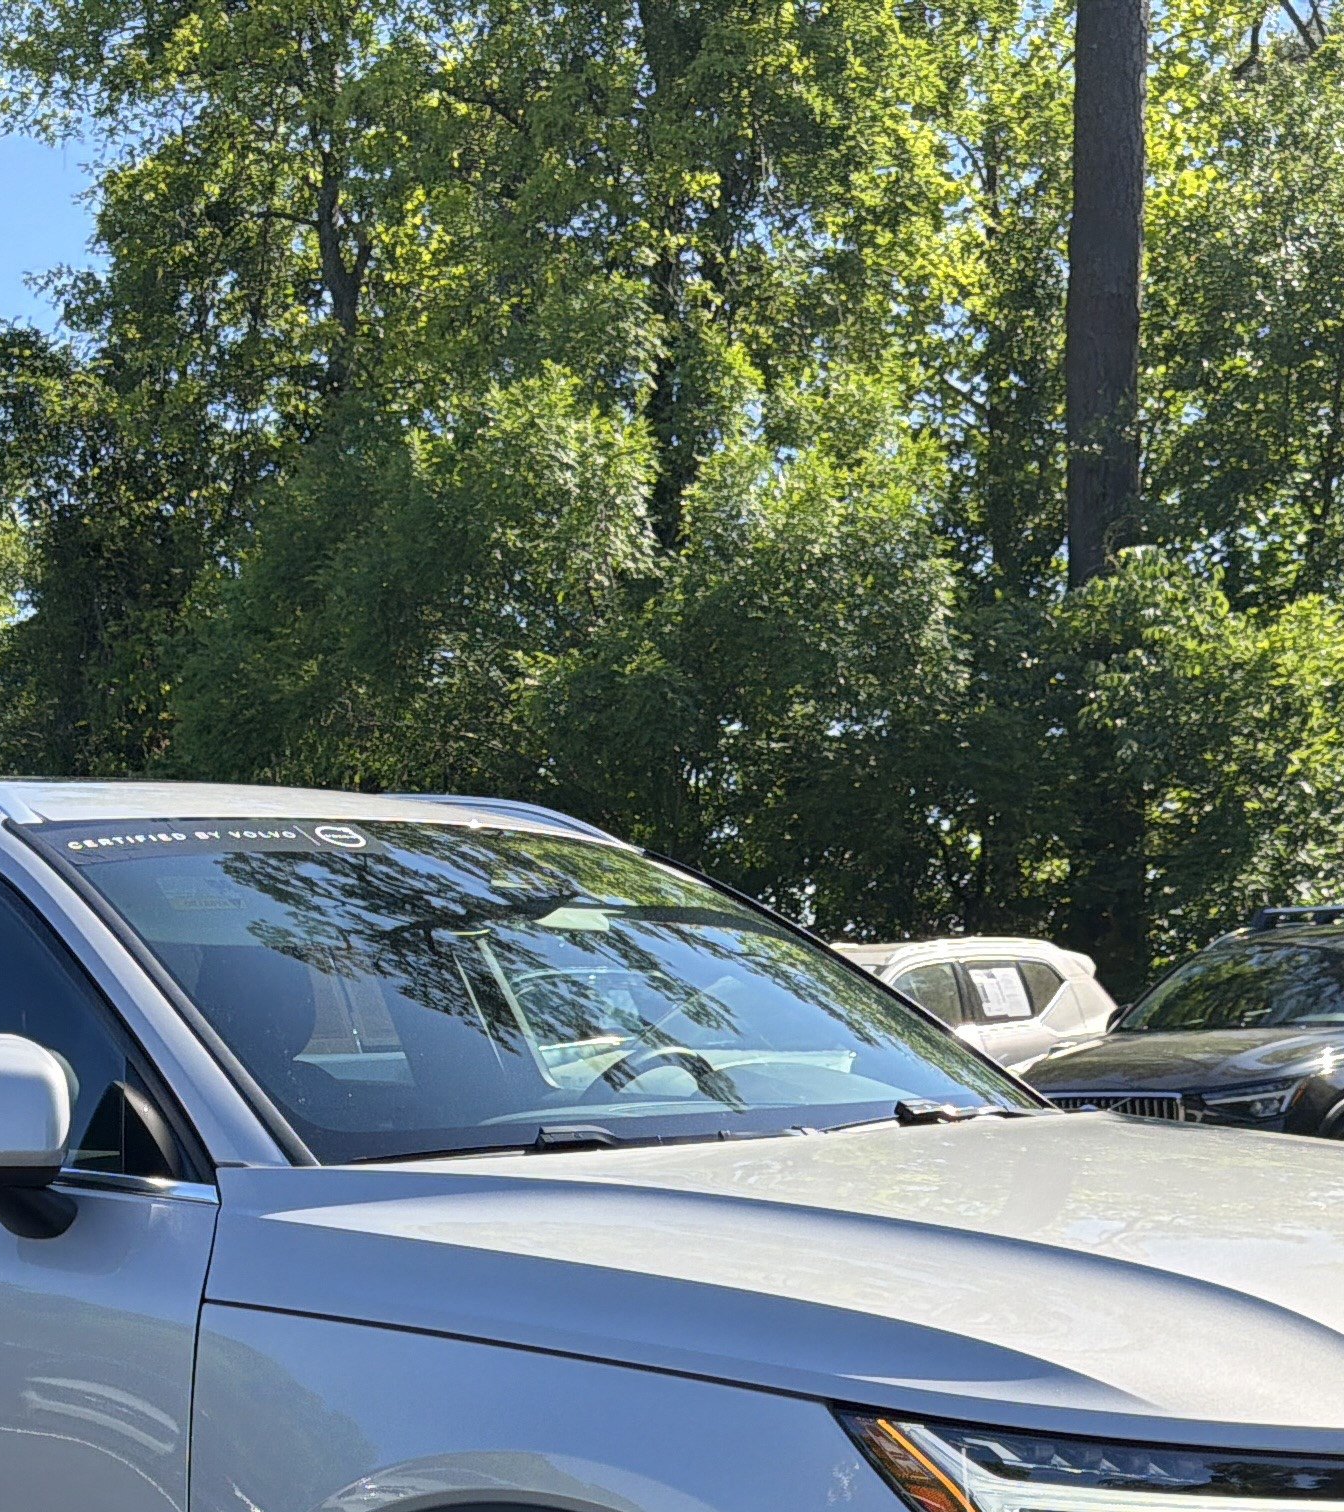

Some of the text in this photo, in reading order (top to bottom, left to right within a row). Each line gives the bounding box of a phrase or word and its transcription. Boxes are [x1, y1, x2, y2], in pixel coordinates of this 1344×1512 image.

[67, 830, 297, 850] CERTIFIED BY VOLVO
